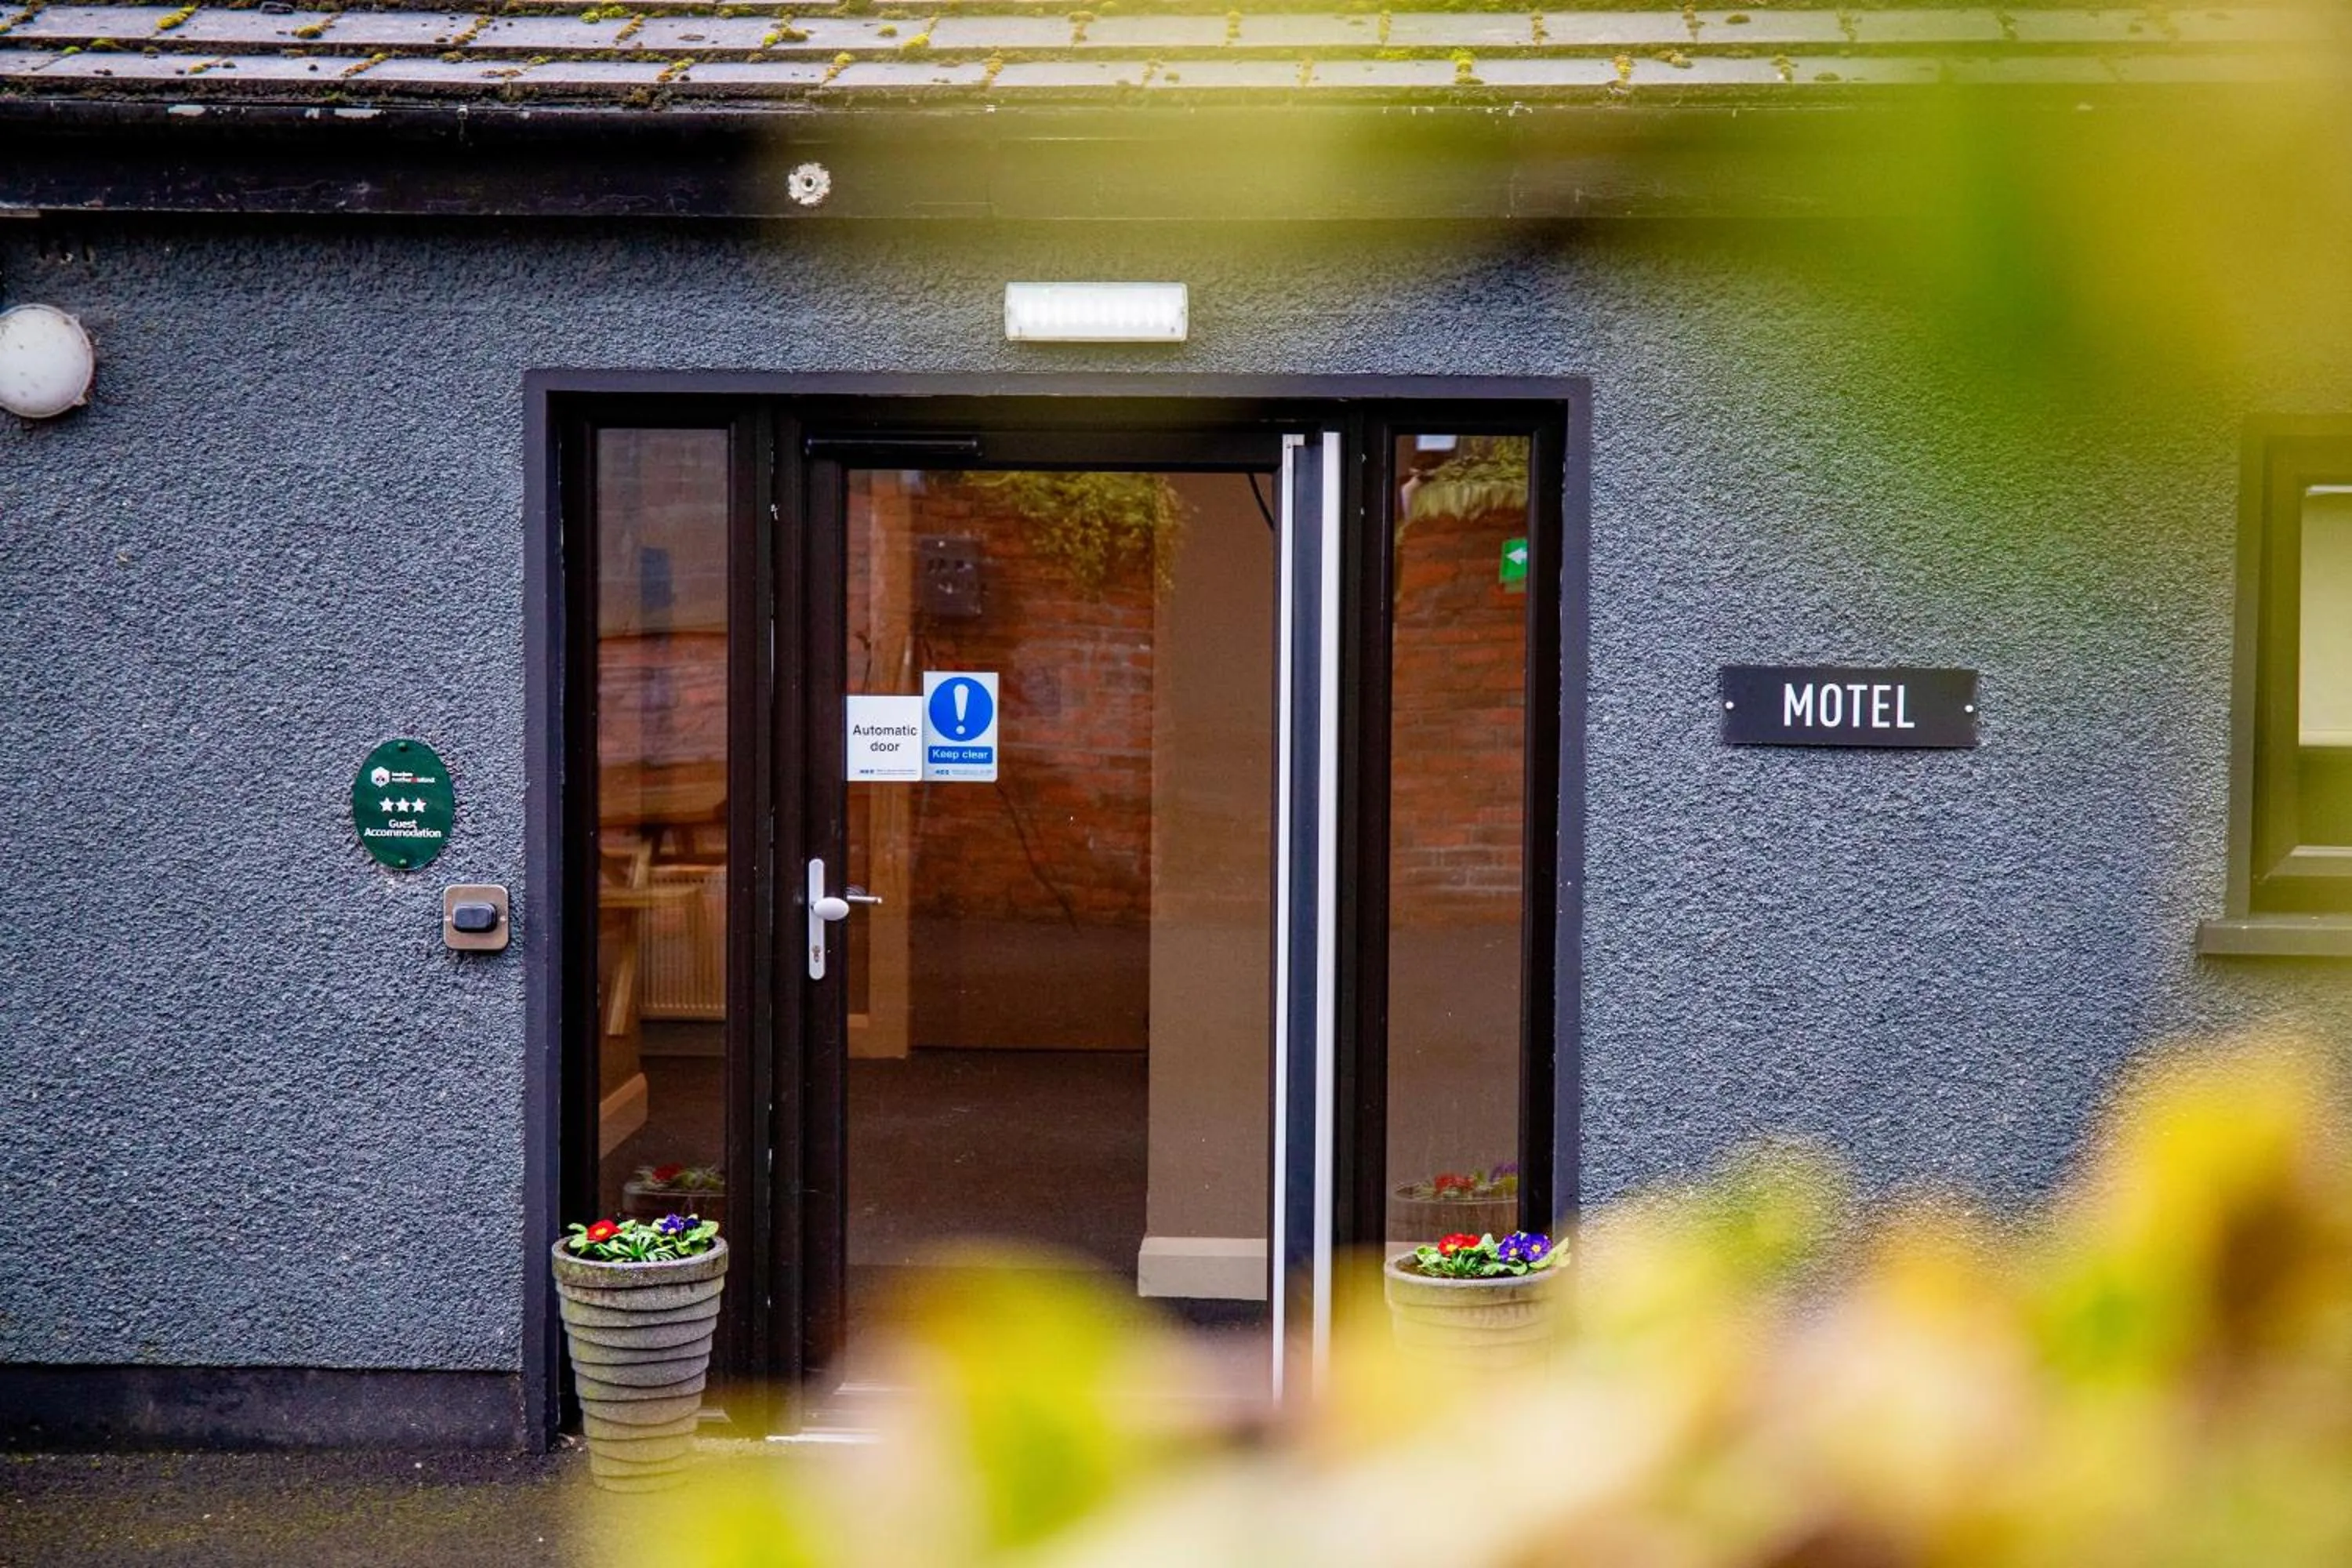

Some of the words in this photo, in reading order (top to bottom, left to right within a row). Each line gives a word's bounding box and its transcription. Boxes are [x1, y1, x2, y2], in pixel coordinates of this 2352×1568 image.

[1783, 683, 1915, 728] MOTEL
[852, 724, 918, 737] Automatic
[869, 741, 901, 753] door
[932, 749, 959, 761] Keep
[962, 749, 989, 760] clear
[388, 819, 418, 829] Guest
[364, 827, 441, 838] Accommodation
